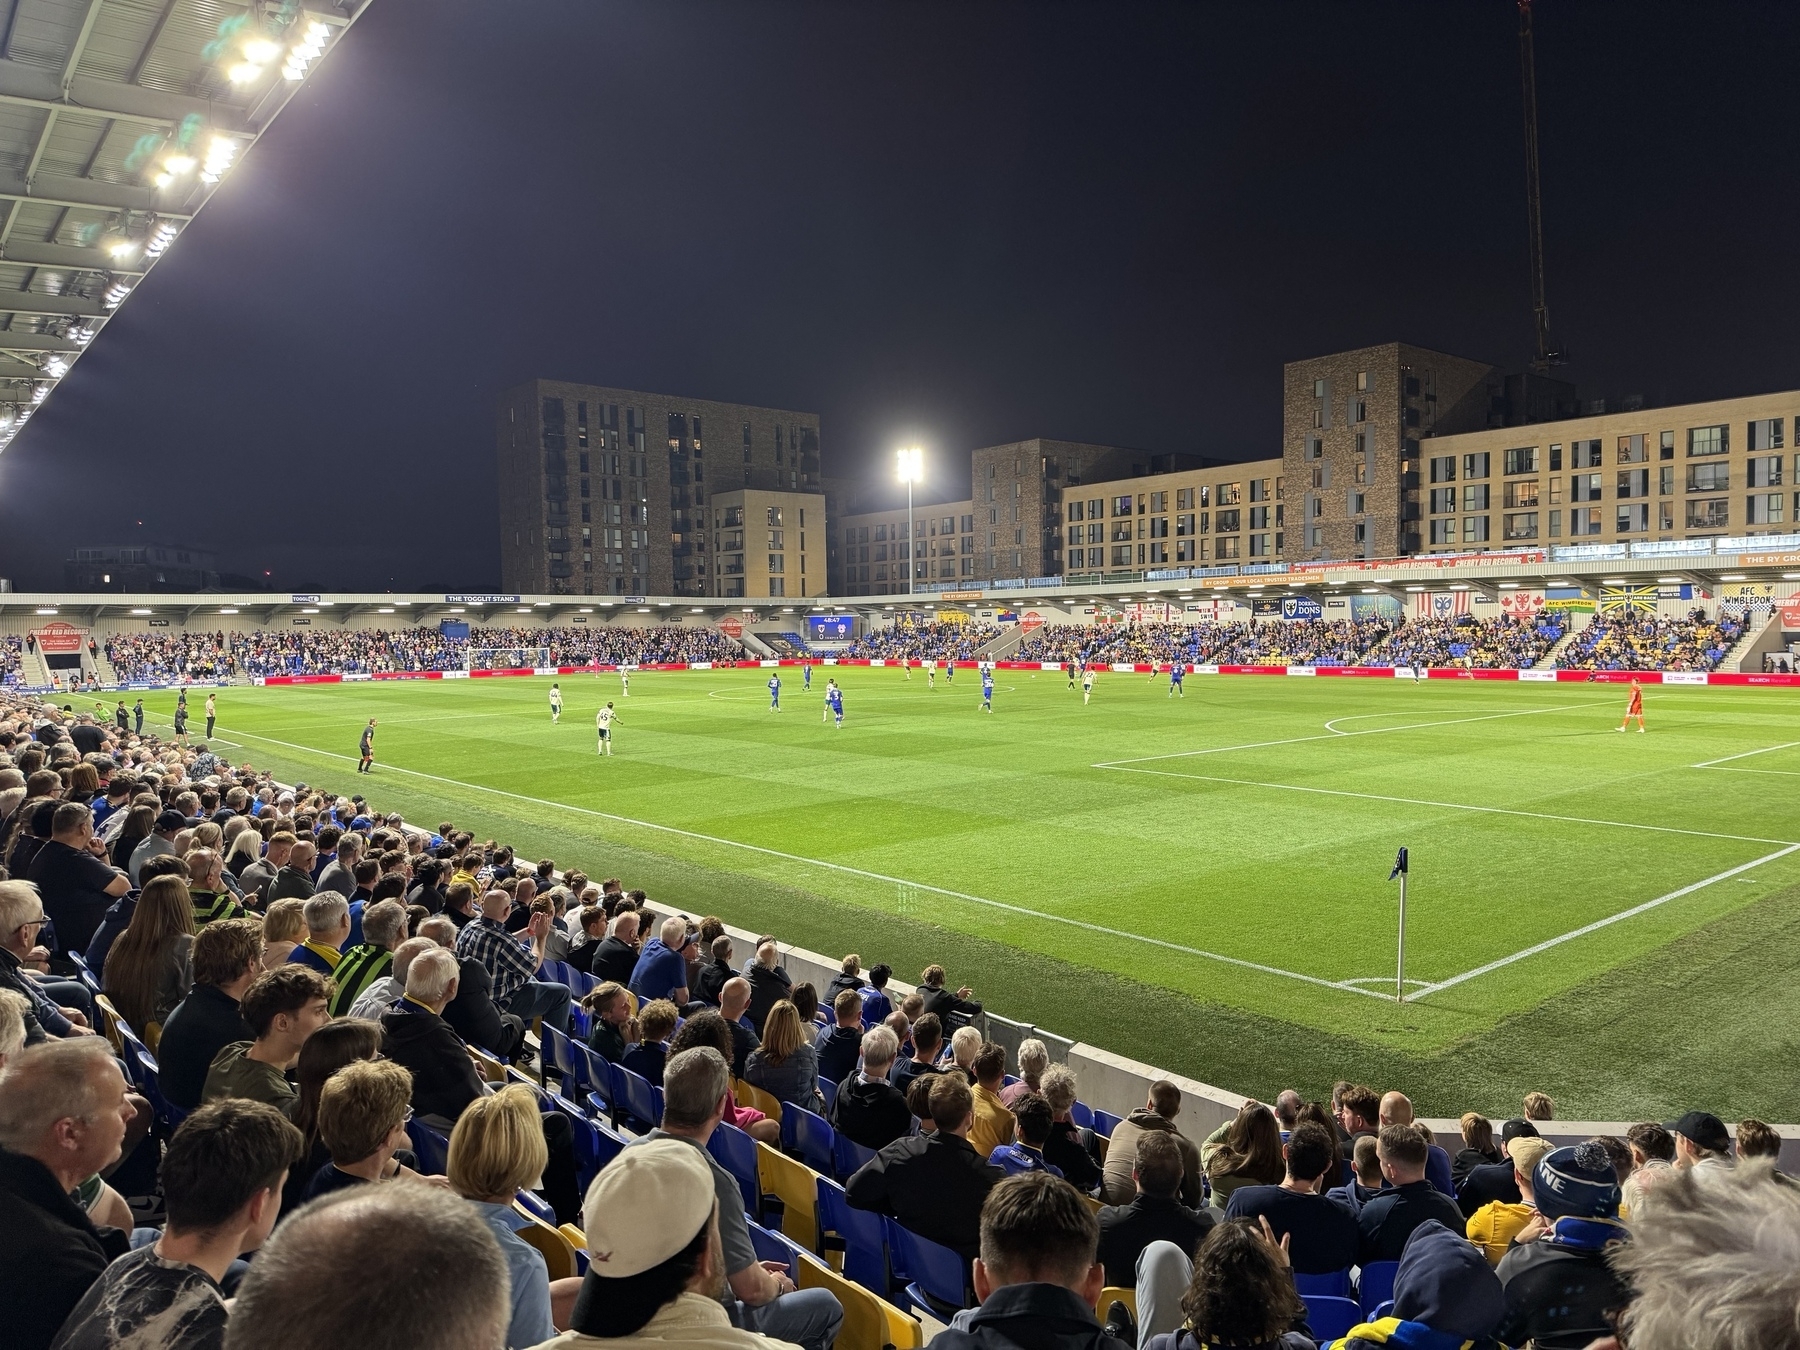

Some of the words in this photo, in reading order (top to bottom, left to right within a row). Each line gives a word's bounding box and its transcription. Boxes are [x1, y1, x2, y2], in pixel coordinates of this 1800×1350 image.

[1455, 559, 1480, 567] CHERRY
[1492, 556, 1522, 565] RECORDS
[1740, 587, 1755, 596] AFC
[1725, 596, 1770, 604] WIMBLEDON
[833, 692, 838, 700] 3
